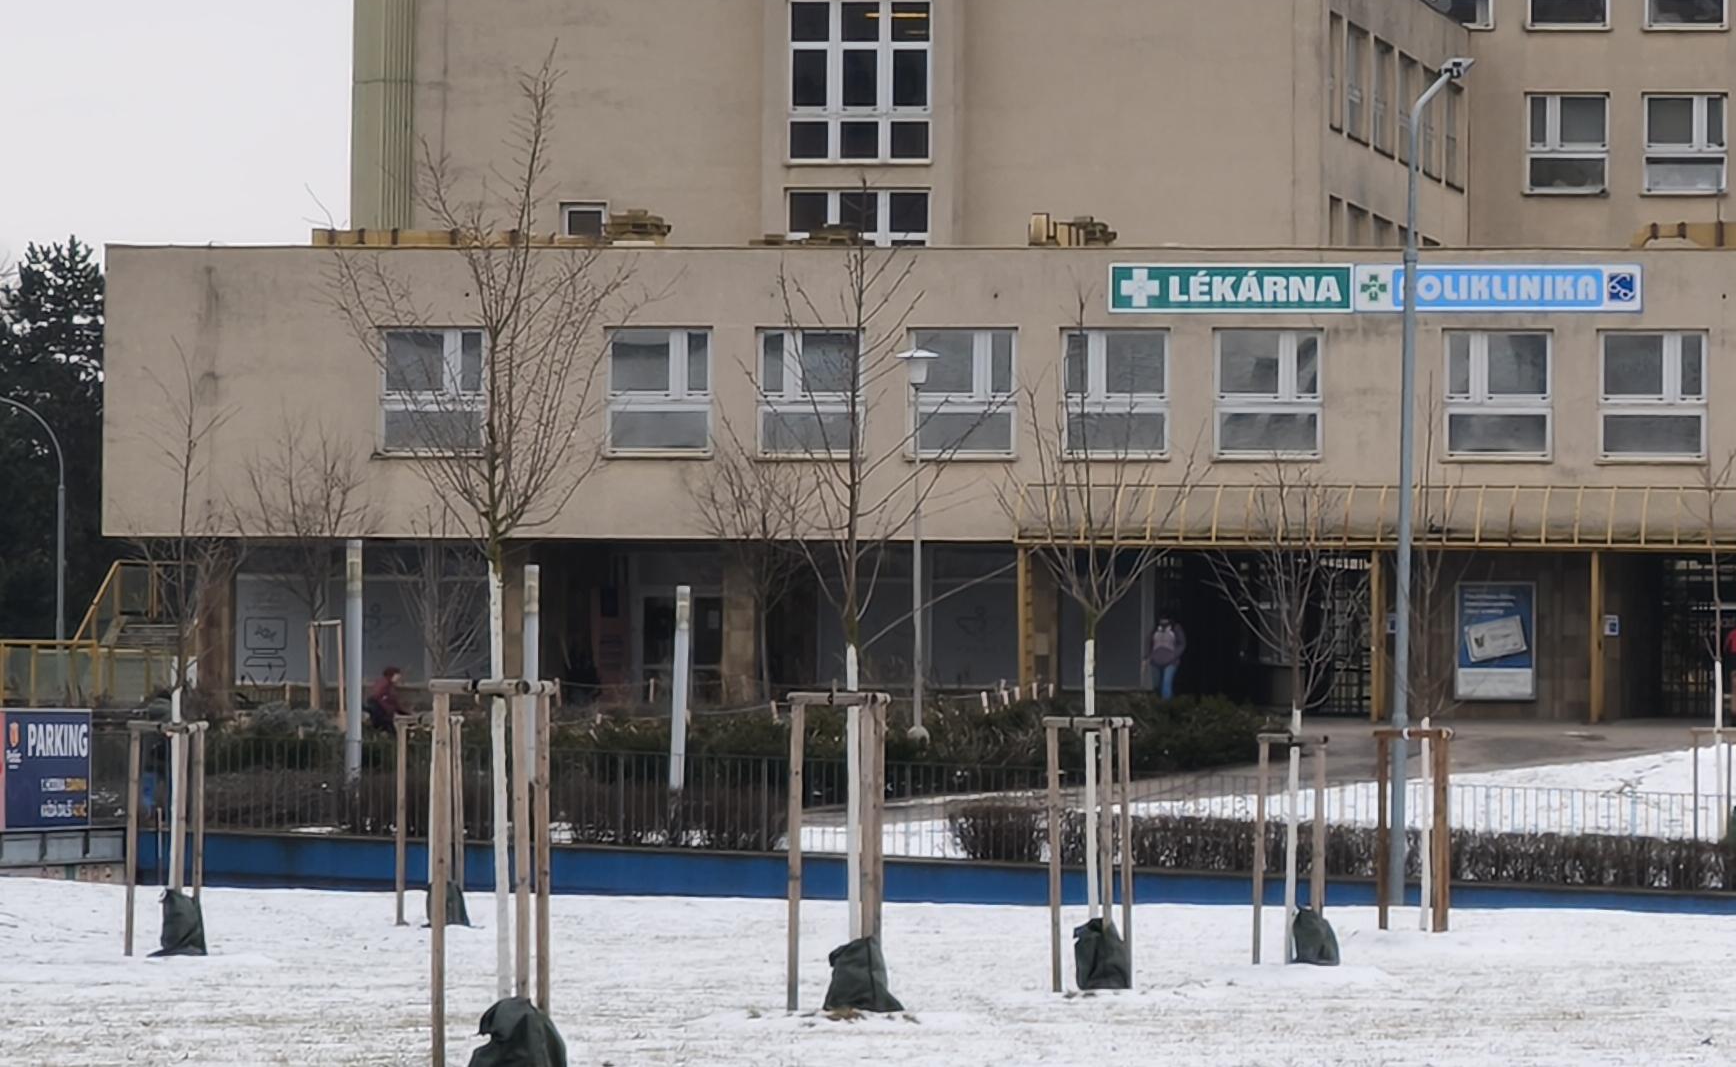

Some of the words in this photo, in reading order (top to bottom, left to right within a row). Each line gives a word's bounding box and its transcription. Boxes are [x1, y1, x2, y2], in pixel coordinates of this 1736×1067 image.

[1168, 271, 1342, 303] LÉKÁRNA
[1398, 274, 1597, 302] OLIKLINIKA
[27, 723, 89, 757] PARKING
